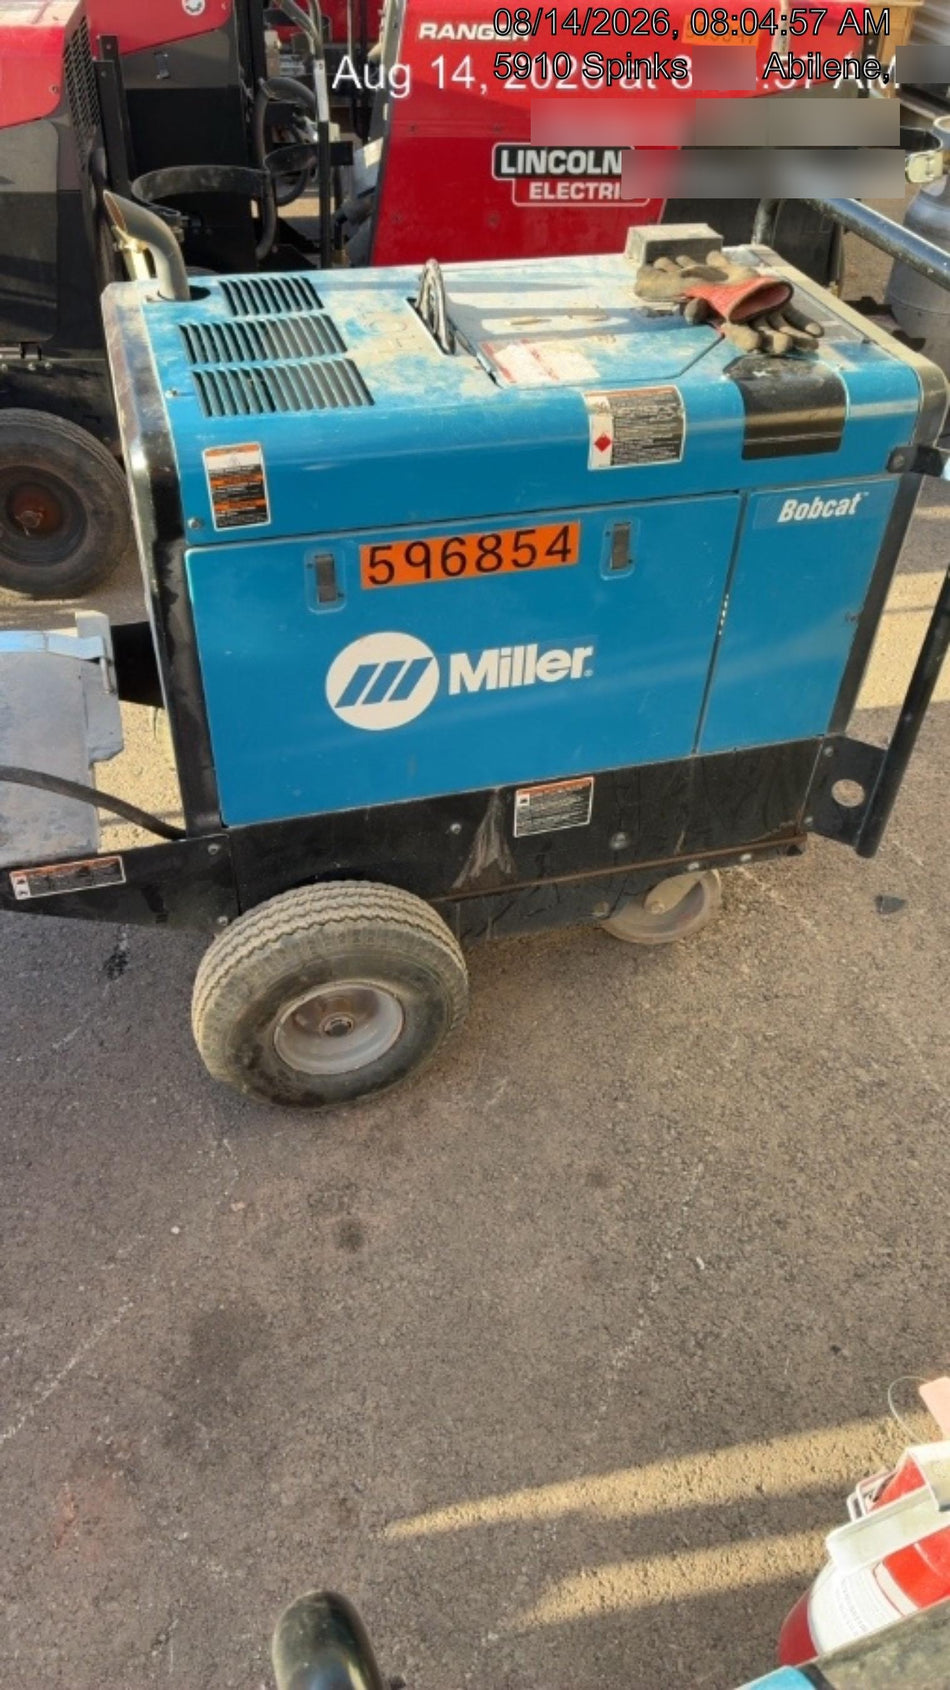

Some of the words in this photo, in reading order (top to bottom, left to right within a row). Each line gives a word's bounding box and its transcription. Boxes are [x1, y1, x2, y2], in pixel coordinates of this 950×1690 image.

[529, 182, 634, 200] ELECTRI
[777, 492, 863, 523] Bobcat
[368, 525, 572, 586] 596854
